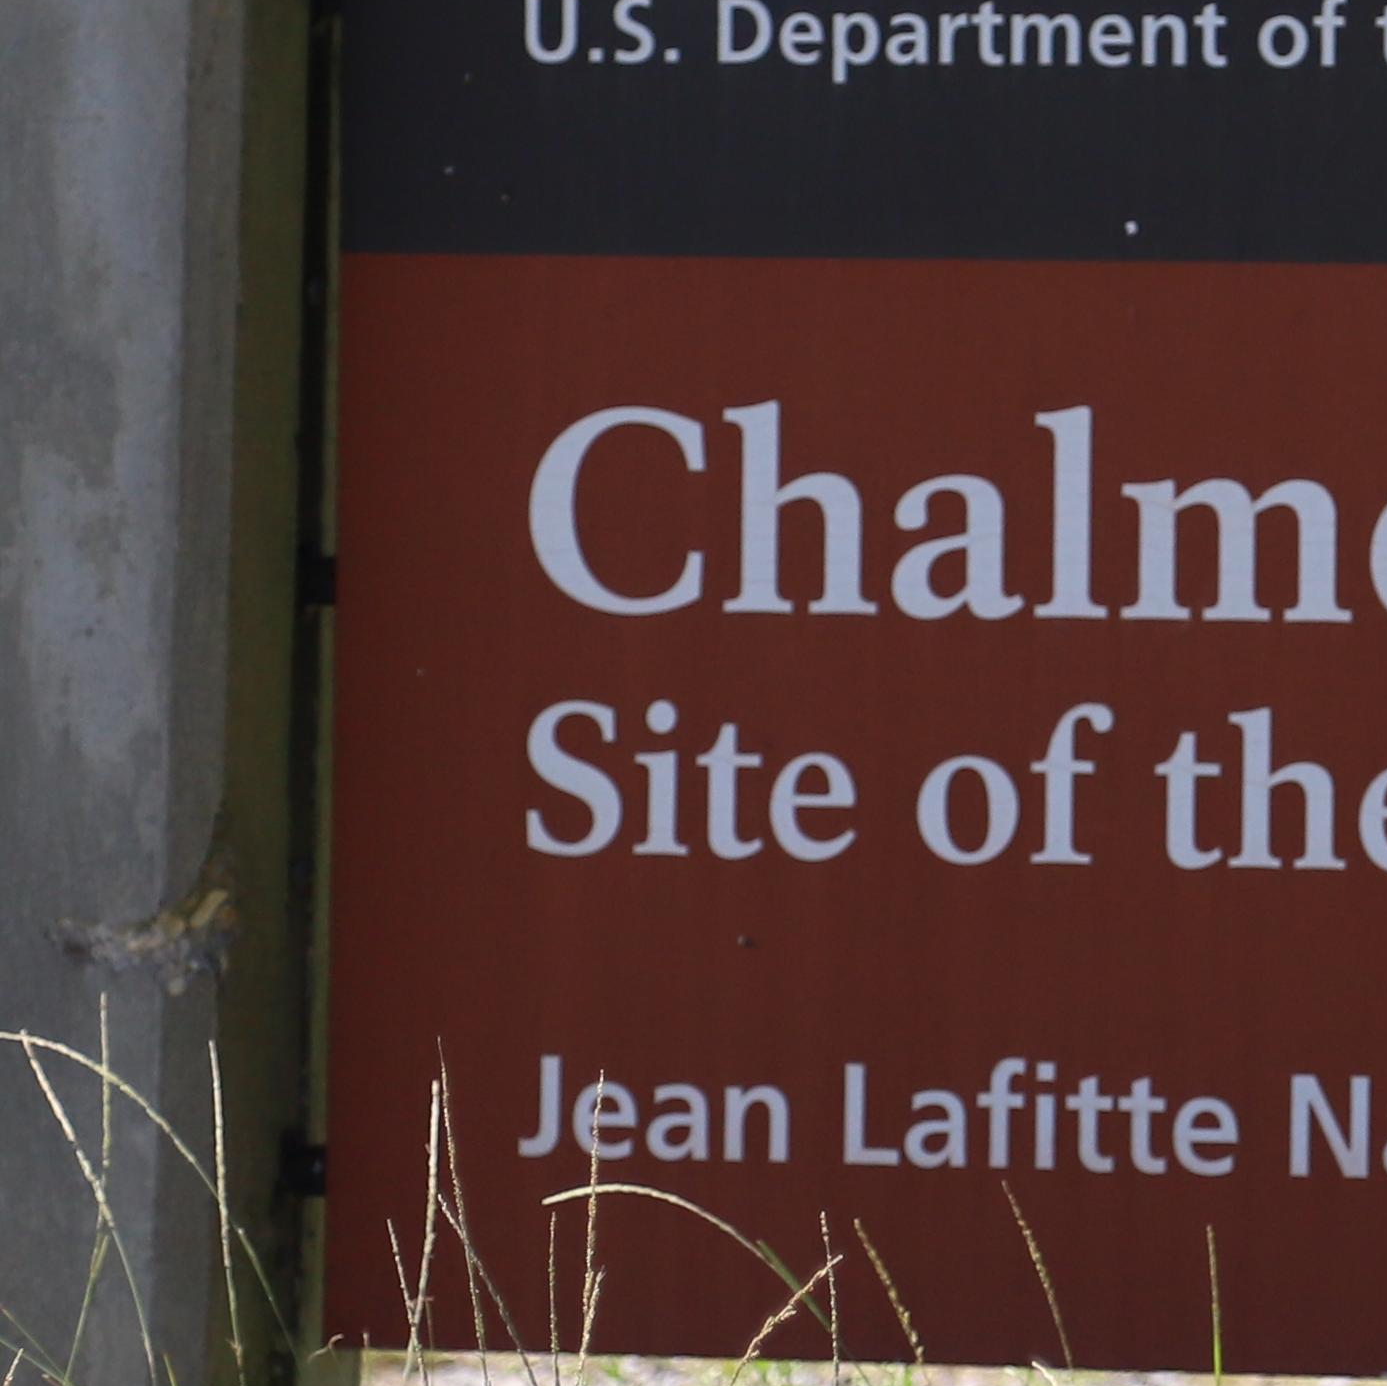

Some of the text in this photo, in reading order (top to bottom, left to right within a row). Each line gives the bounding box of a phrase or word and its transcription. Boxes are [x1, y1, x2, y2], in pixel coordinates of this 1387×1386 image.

[526, 700, 855, 862] Site
[917, 703, 1113, 865] of
[519, 1055, 792, 1167] Jean
[844, 1058, 1238, 1176] Lafitte
